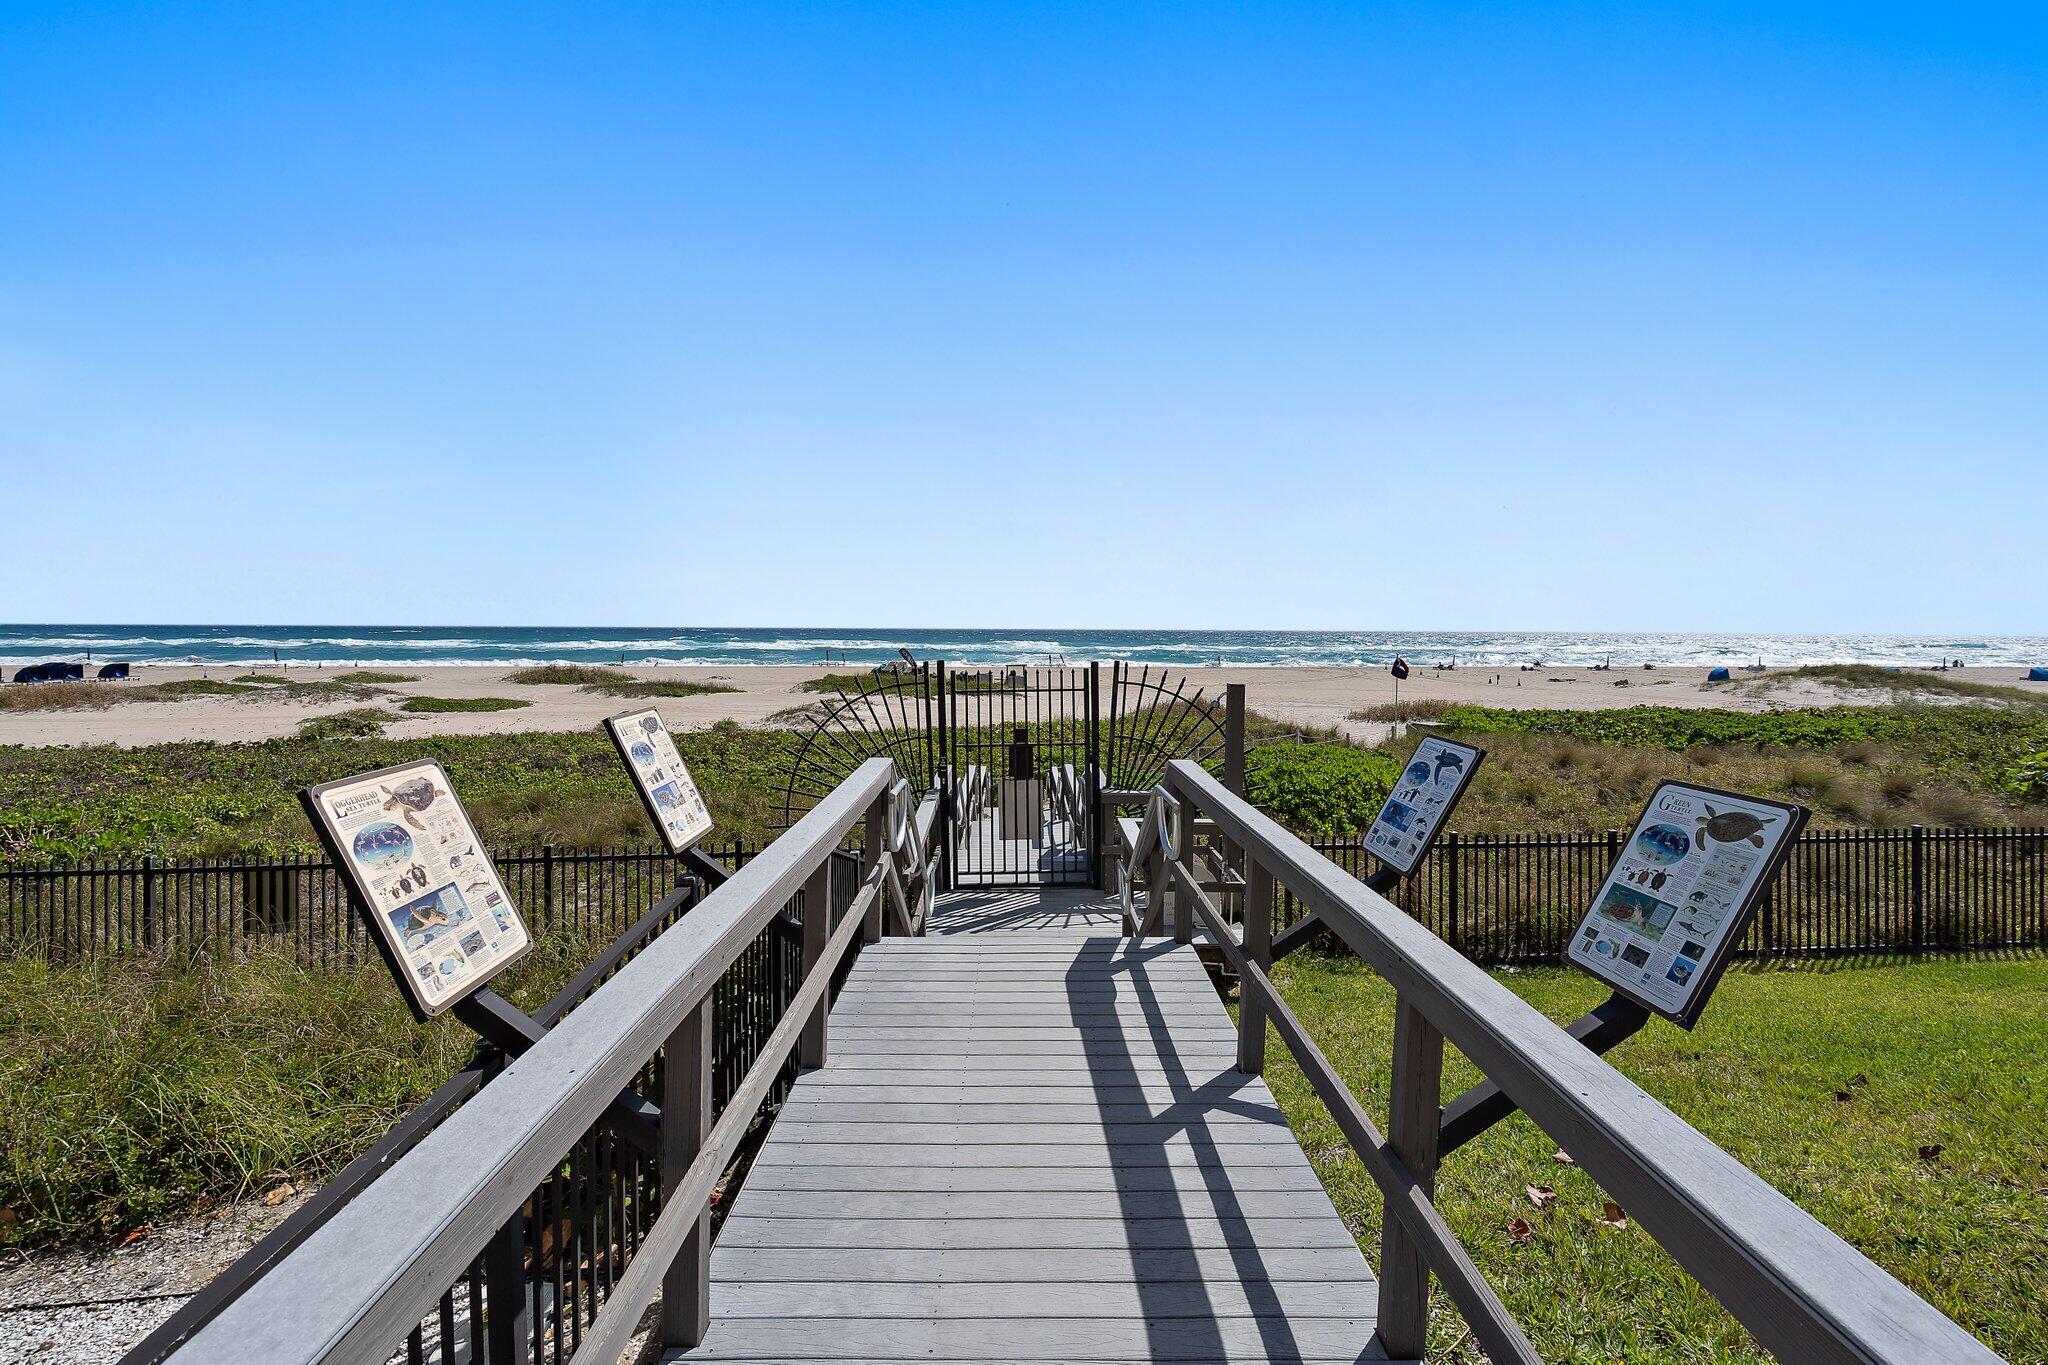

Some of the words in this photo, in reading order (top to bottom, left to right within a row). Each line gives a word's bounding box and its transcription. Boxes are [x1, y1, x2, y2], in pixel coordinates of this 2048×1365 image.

[330, 790, 378, 819] LOGGERHEAD
[345, 802, 359, 813] SEA
[359, 798, 382, 809] TURTLE
[1658, 795, 1692, 811] GREEN
[1670, 803, 1693, 814] TURTLE
